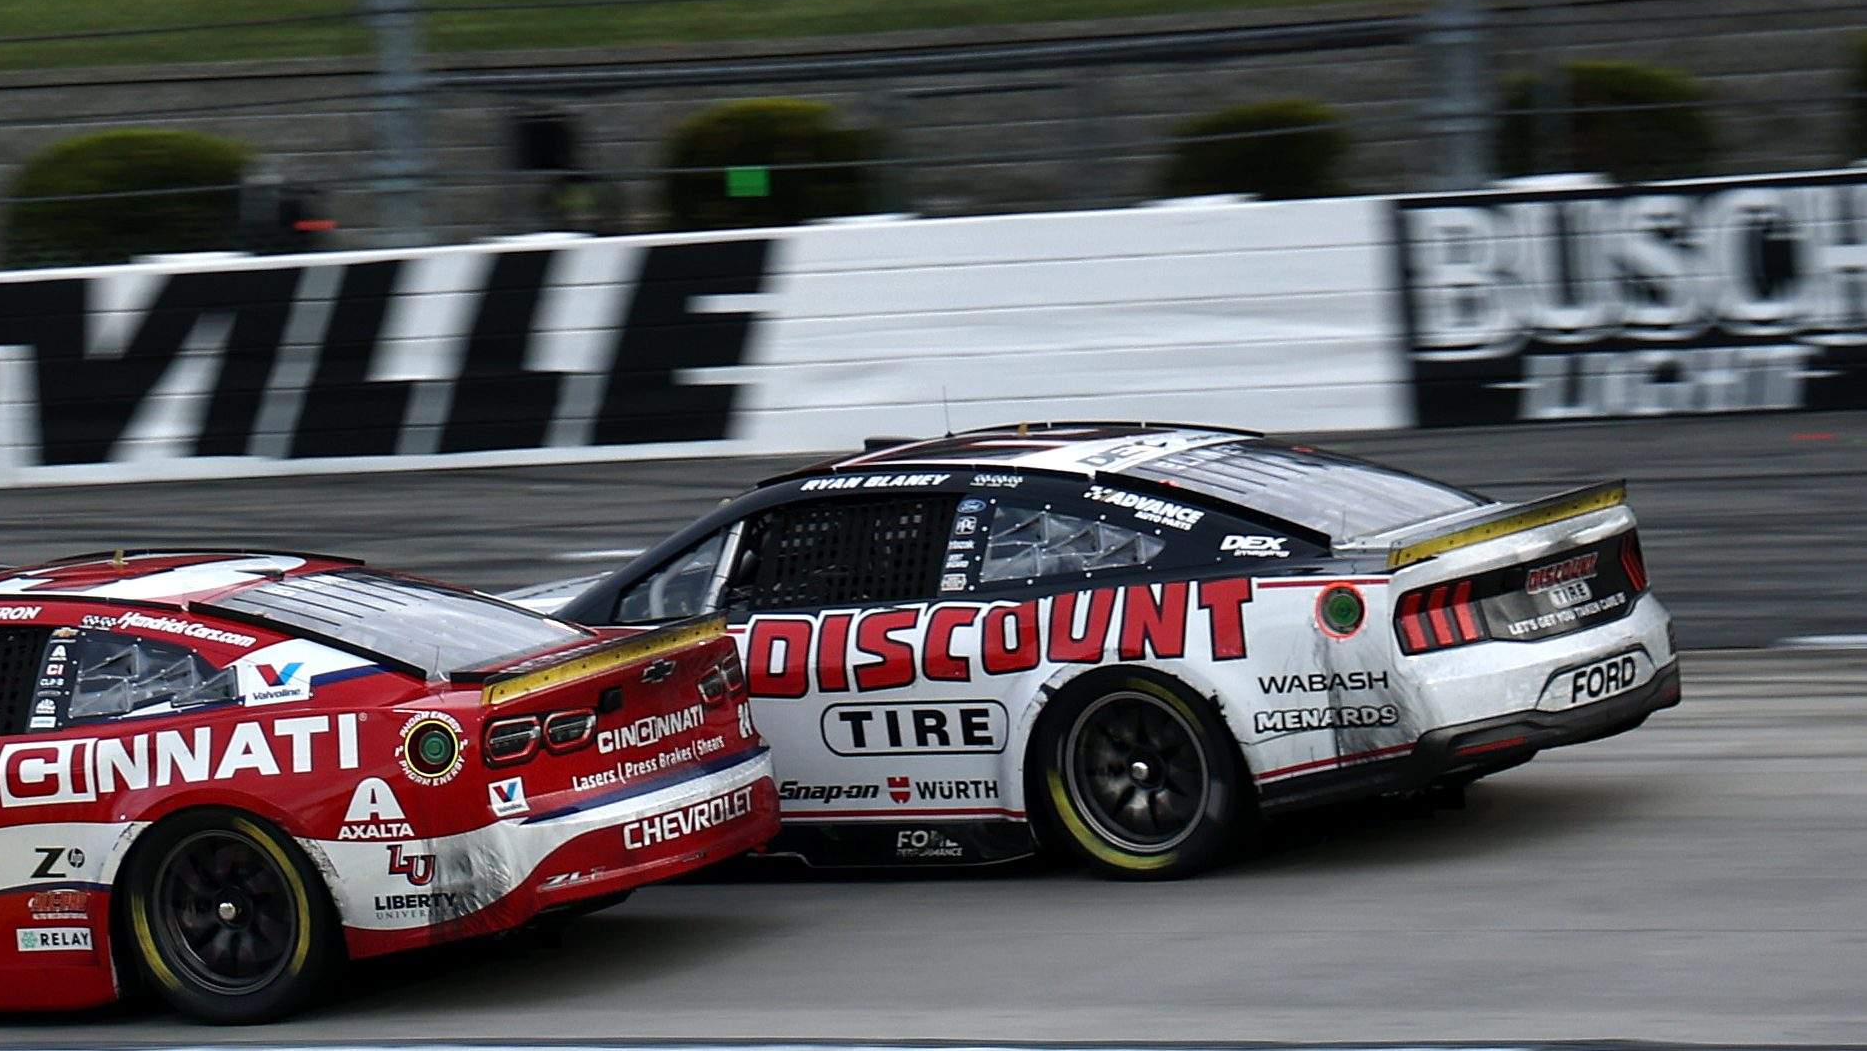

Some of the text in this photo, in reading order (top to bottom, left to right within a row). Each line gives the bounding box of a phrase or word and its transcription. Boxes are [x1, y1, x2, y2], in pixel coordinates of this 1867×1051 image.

[1520, 347, 1819, 418] LIGHT
[800, 473, 950, 491] RYAN BLANEY
[1107, 490, 1205, 523] ADVANCE
[1134, 512, 1193, 530] AUTO PARTS
[1220, 535, 1287, 550] DEX
[1234, 549, 1290, 559] imaging
[117, 611, 257, 648] HendrickCars.com
[746, 576, 1254, 699] DISCOUNT
[1258, 671, 1389, 694] WABASH
[1571, 656, 1636, 703] FORD
[252, 688, 302, 701] Valvoline
[597, 703, 704, 754] CINCINNATI
[838, 708, 994, 749] TIRE
[1255, 705, 1399, 733] MENARDS
[432, 756, 465, 786] ENERGY
[572, 769, 616, 792] Lasers
[626, 758, 658, 780] Press
[658, 747, 692, 768] Brakes
[780, 780, 879, 803] Snap-on
[338, 823, 415, 840] AXALTA
[623, 786, 753, 850] CHEVROLET
[375, 893, 456, 911] LIBERTY
[39, 932, 89, 946] RELAY
